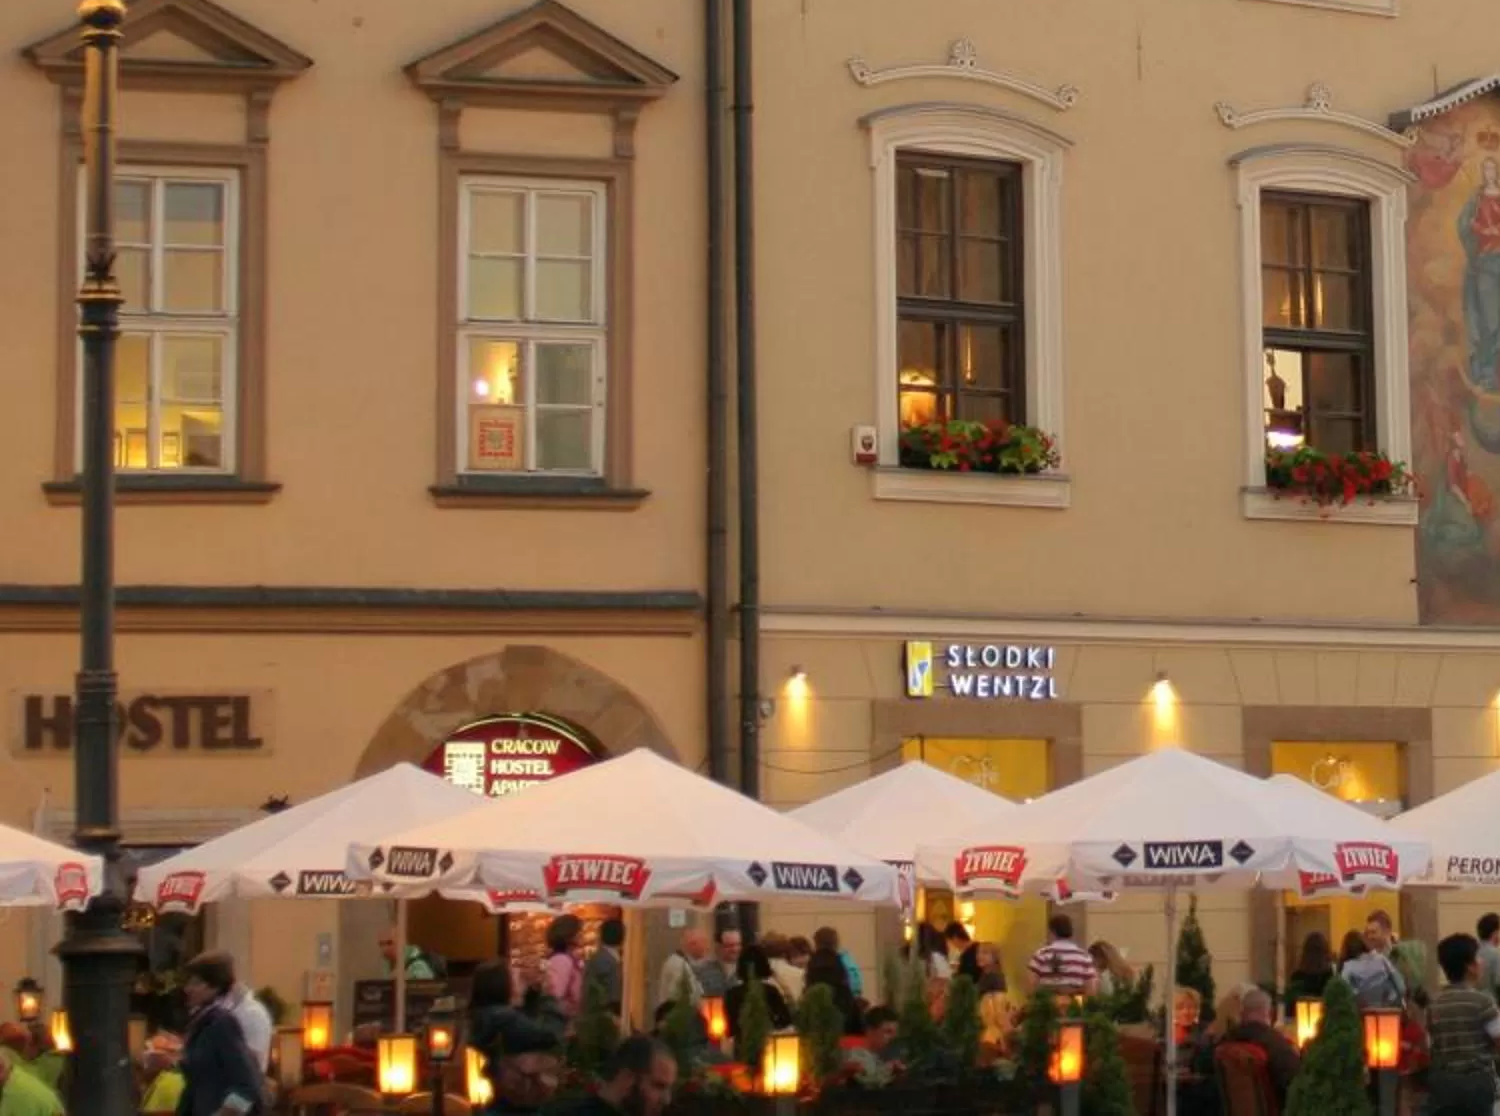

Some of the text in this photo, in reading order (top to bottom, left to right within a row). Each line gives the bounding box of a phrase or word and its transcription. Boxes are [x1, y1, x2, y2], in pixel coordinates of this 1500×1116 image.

[947, 644, 1055, 669] SŁODKI
[951, 674, 1059, 699] WENTZL
[25, 695, 263, 750] HSTEL
[491, 739, 561, 755] CRACOW
[490, 759, 555, 775] HOSTEL
[1150, 843, 1216, 865] WIWA
[776, 865, 834, 889] WIWA
